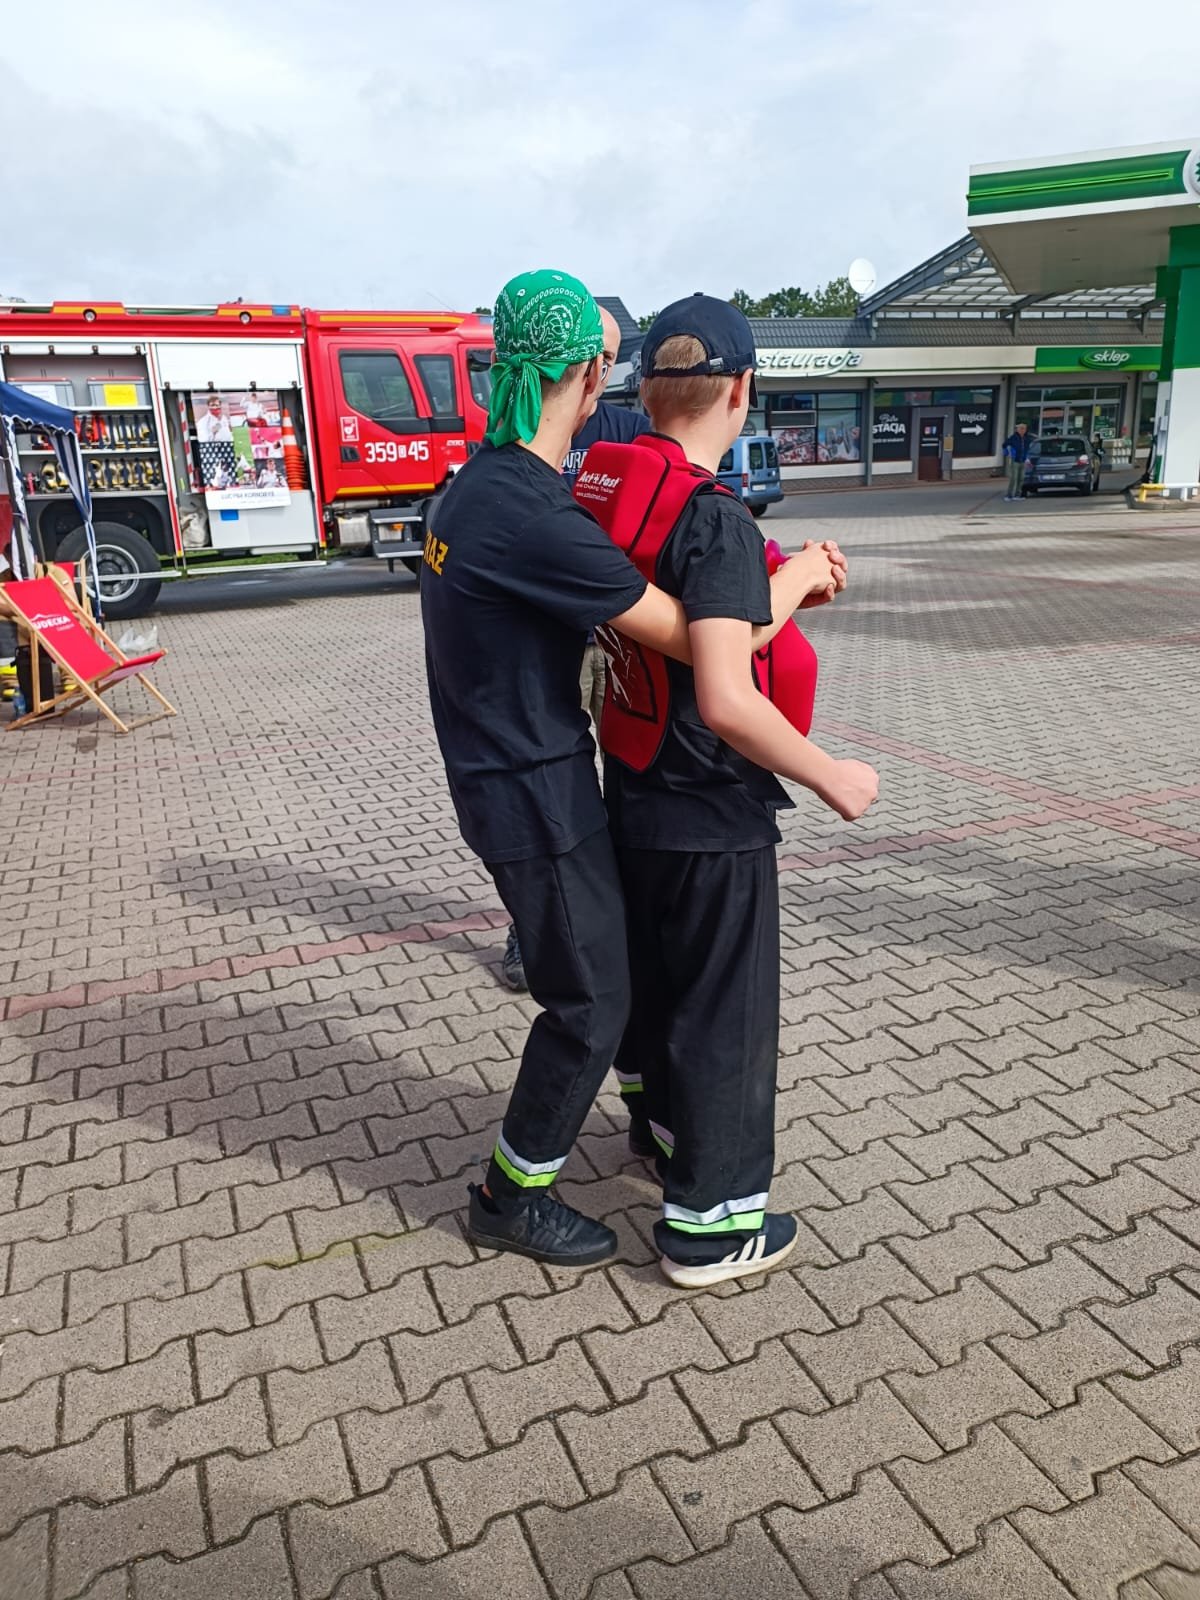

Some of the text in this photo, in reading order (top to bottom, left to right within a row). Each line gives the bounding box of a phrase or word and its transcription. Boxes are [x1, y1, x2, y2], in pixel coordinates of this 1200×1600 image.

[757, 349, 863, 372] stauracja
[1092, 350, 1130, 365] sklep
[872, 423, 906, 434] STACJA
[364, 442, 397, 463] 359
[408, 441, 430, 461] 45
[598, 473, 621, 488] Fast
